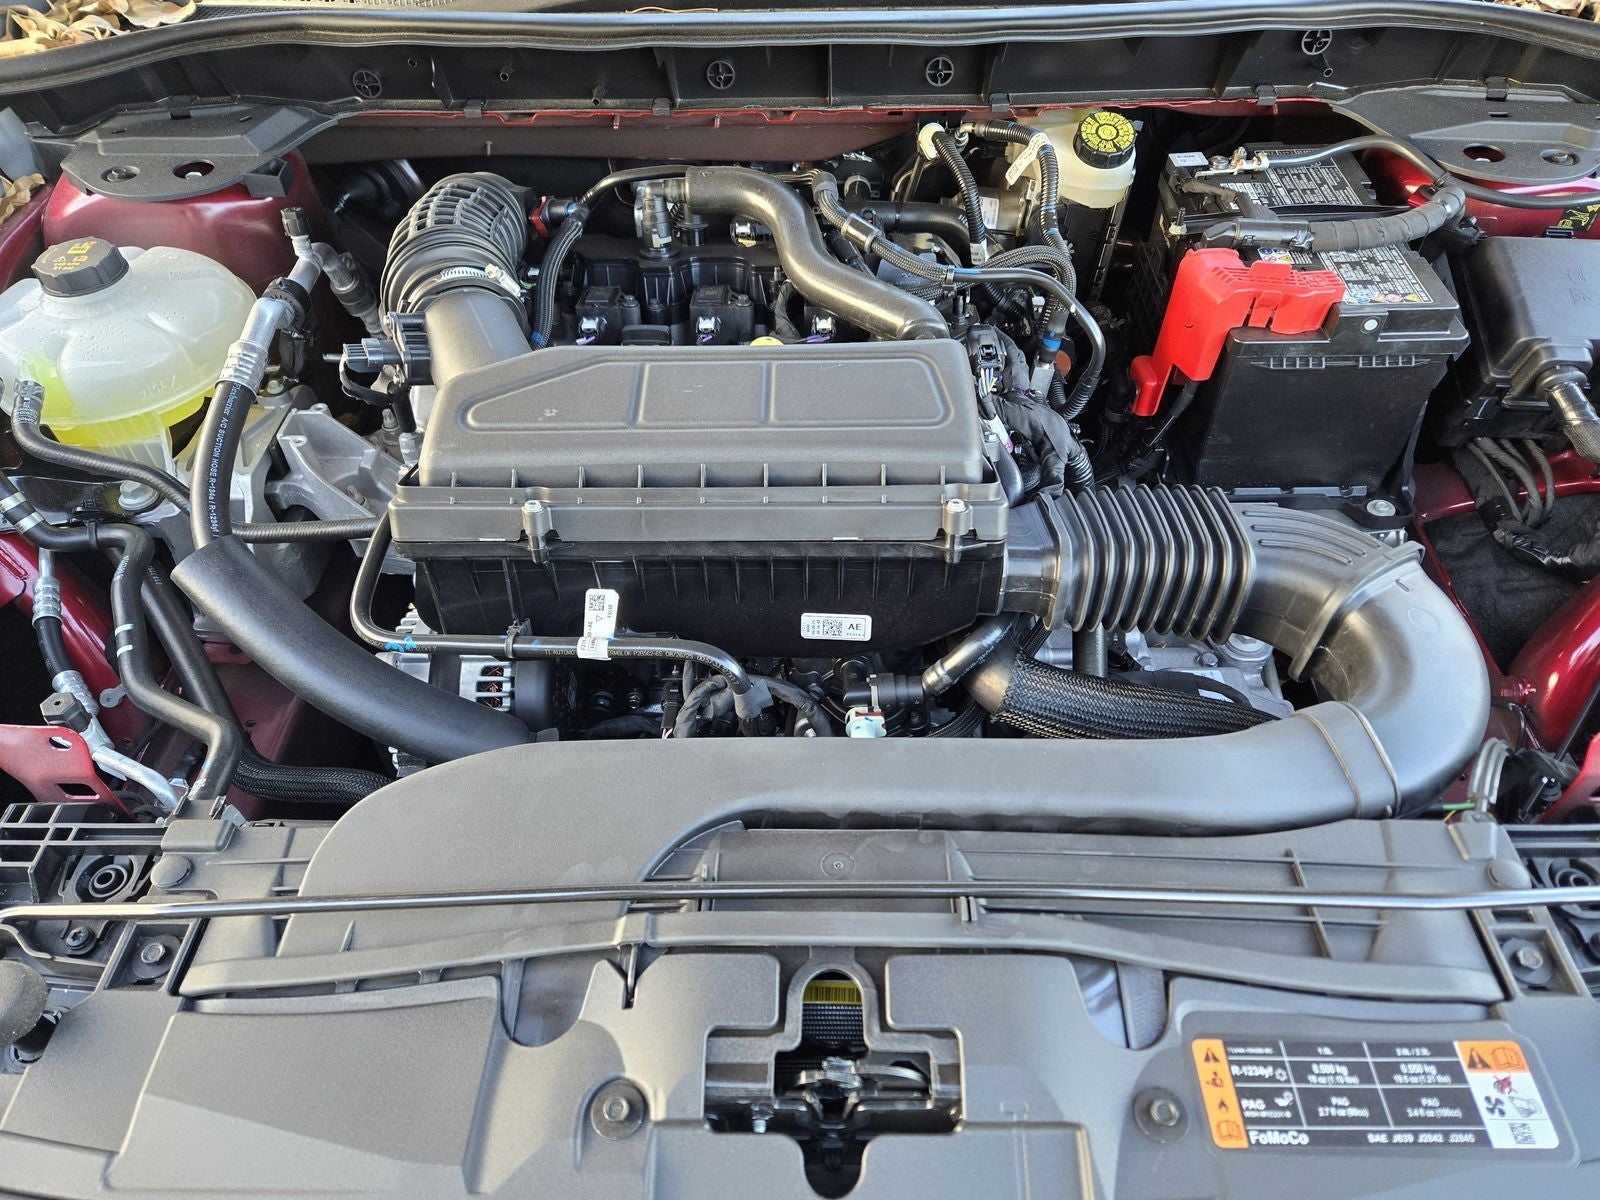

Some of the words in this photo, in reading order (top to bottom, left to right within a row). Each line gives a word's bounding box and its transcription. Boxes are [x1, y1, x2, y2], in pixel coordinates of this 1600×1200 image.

[219, 416, 229, 429] A/C
[213, 429, 226, 458] SUCTION
[209, 457, 220, 478] HOSE
[847, 623, 863, 631] AE
[1240, 1097, 1266, 1111] PAG
[1248, 1130, 1310, 1145] FoMoCo
[1366, 1132, 1389, 1143] SAE
